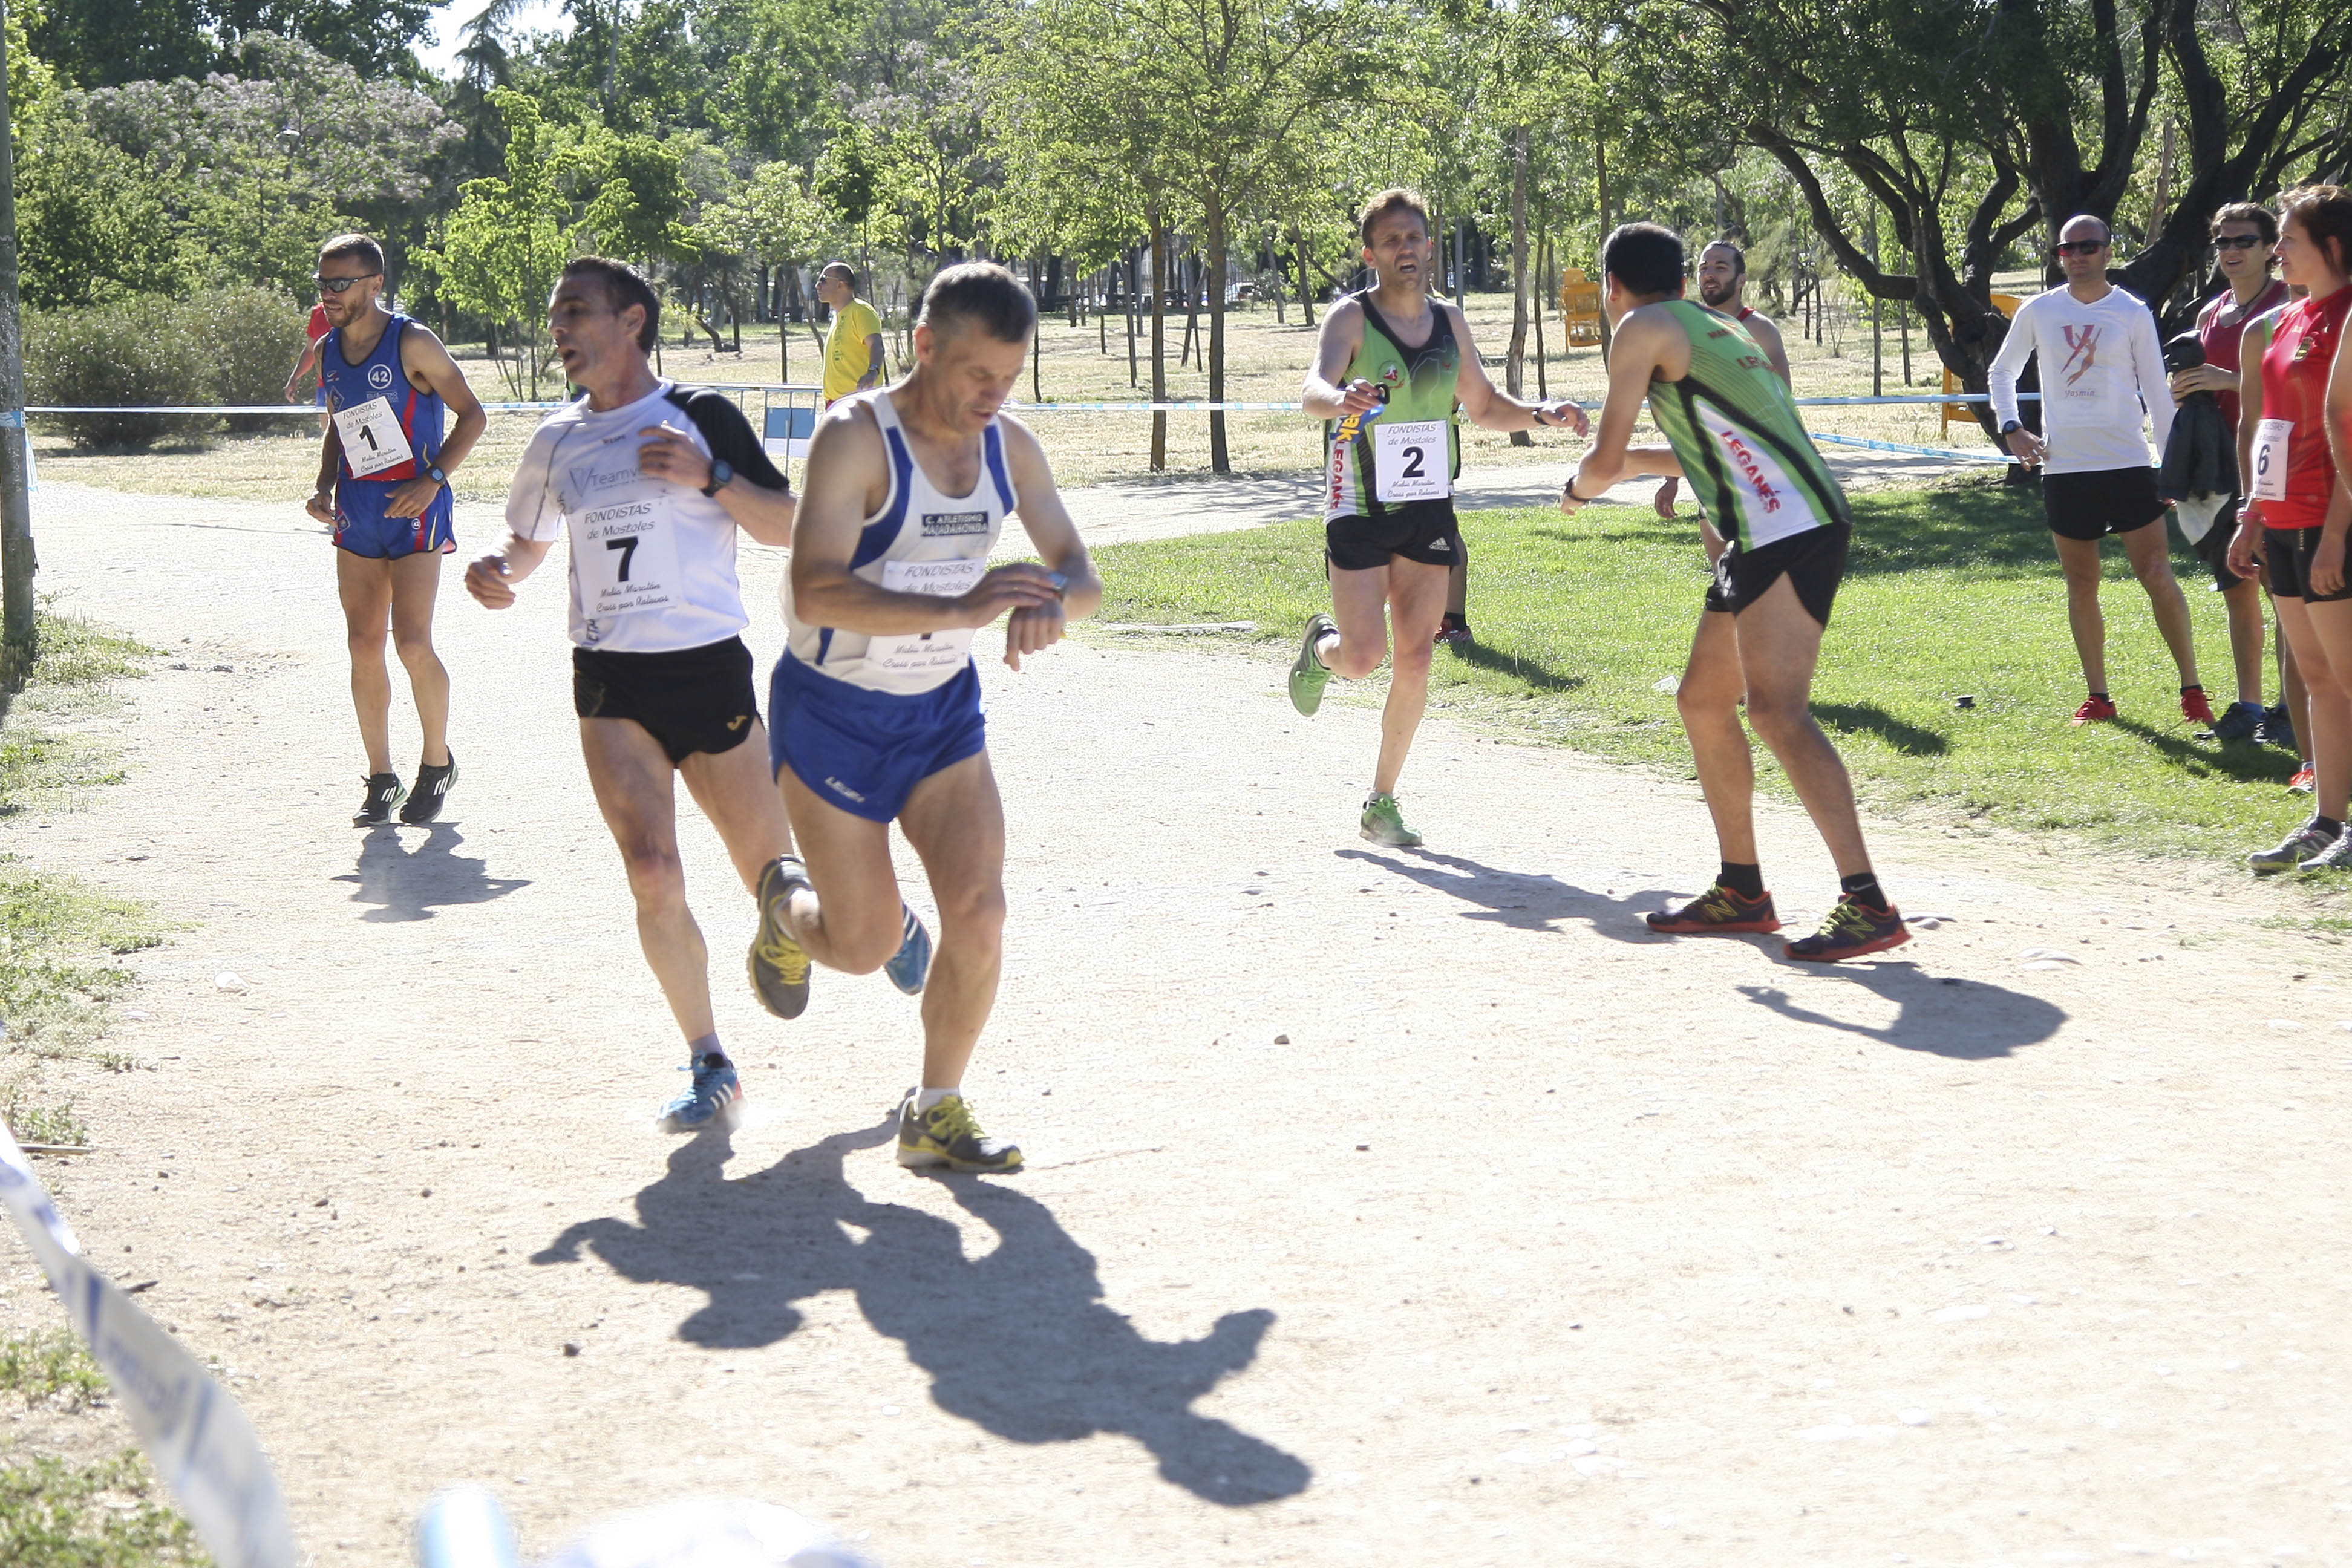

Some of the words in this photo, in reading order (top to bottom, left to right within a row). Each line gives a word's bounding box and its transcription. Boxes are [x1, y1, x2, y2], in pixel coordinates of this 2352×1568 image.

[371, 371, 388, 382] 42
[343, 402, 378, 419] FONDISTAS
[346, 420, 355, 429] de
[1388, 424, 1437, 434] FONDISTAS
[359, 425, 379, 451] 1
[1400, 436, 1437, 445] Mostoles
[1402, 446, 1425, 478] 2
[2258, 443, 2271, 475] 6
[584, 503, 652, 523] FONDISTAS
[587, 528, 598, 540] de
[602, 521, 655, 537] Mostoles
[606, 535, 639, 582] 7
[904, 563, 976, 577] FONDISTAS
